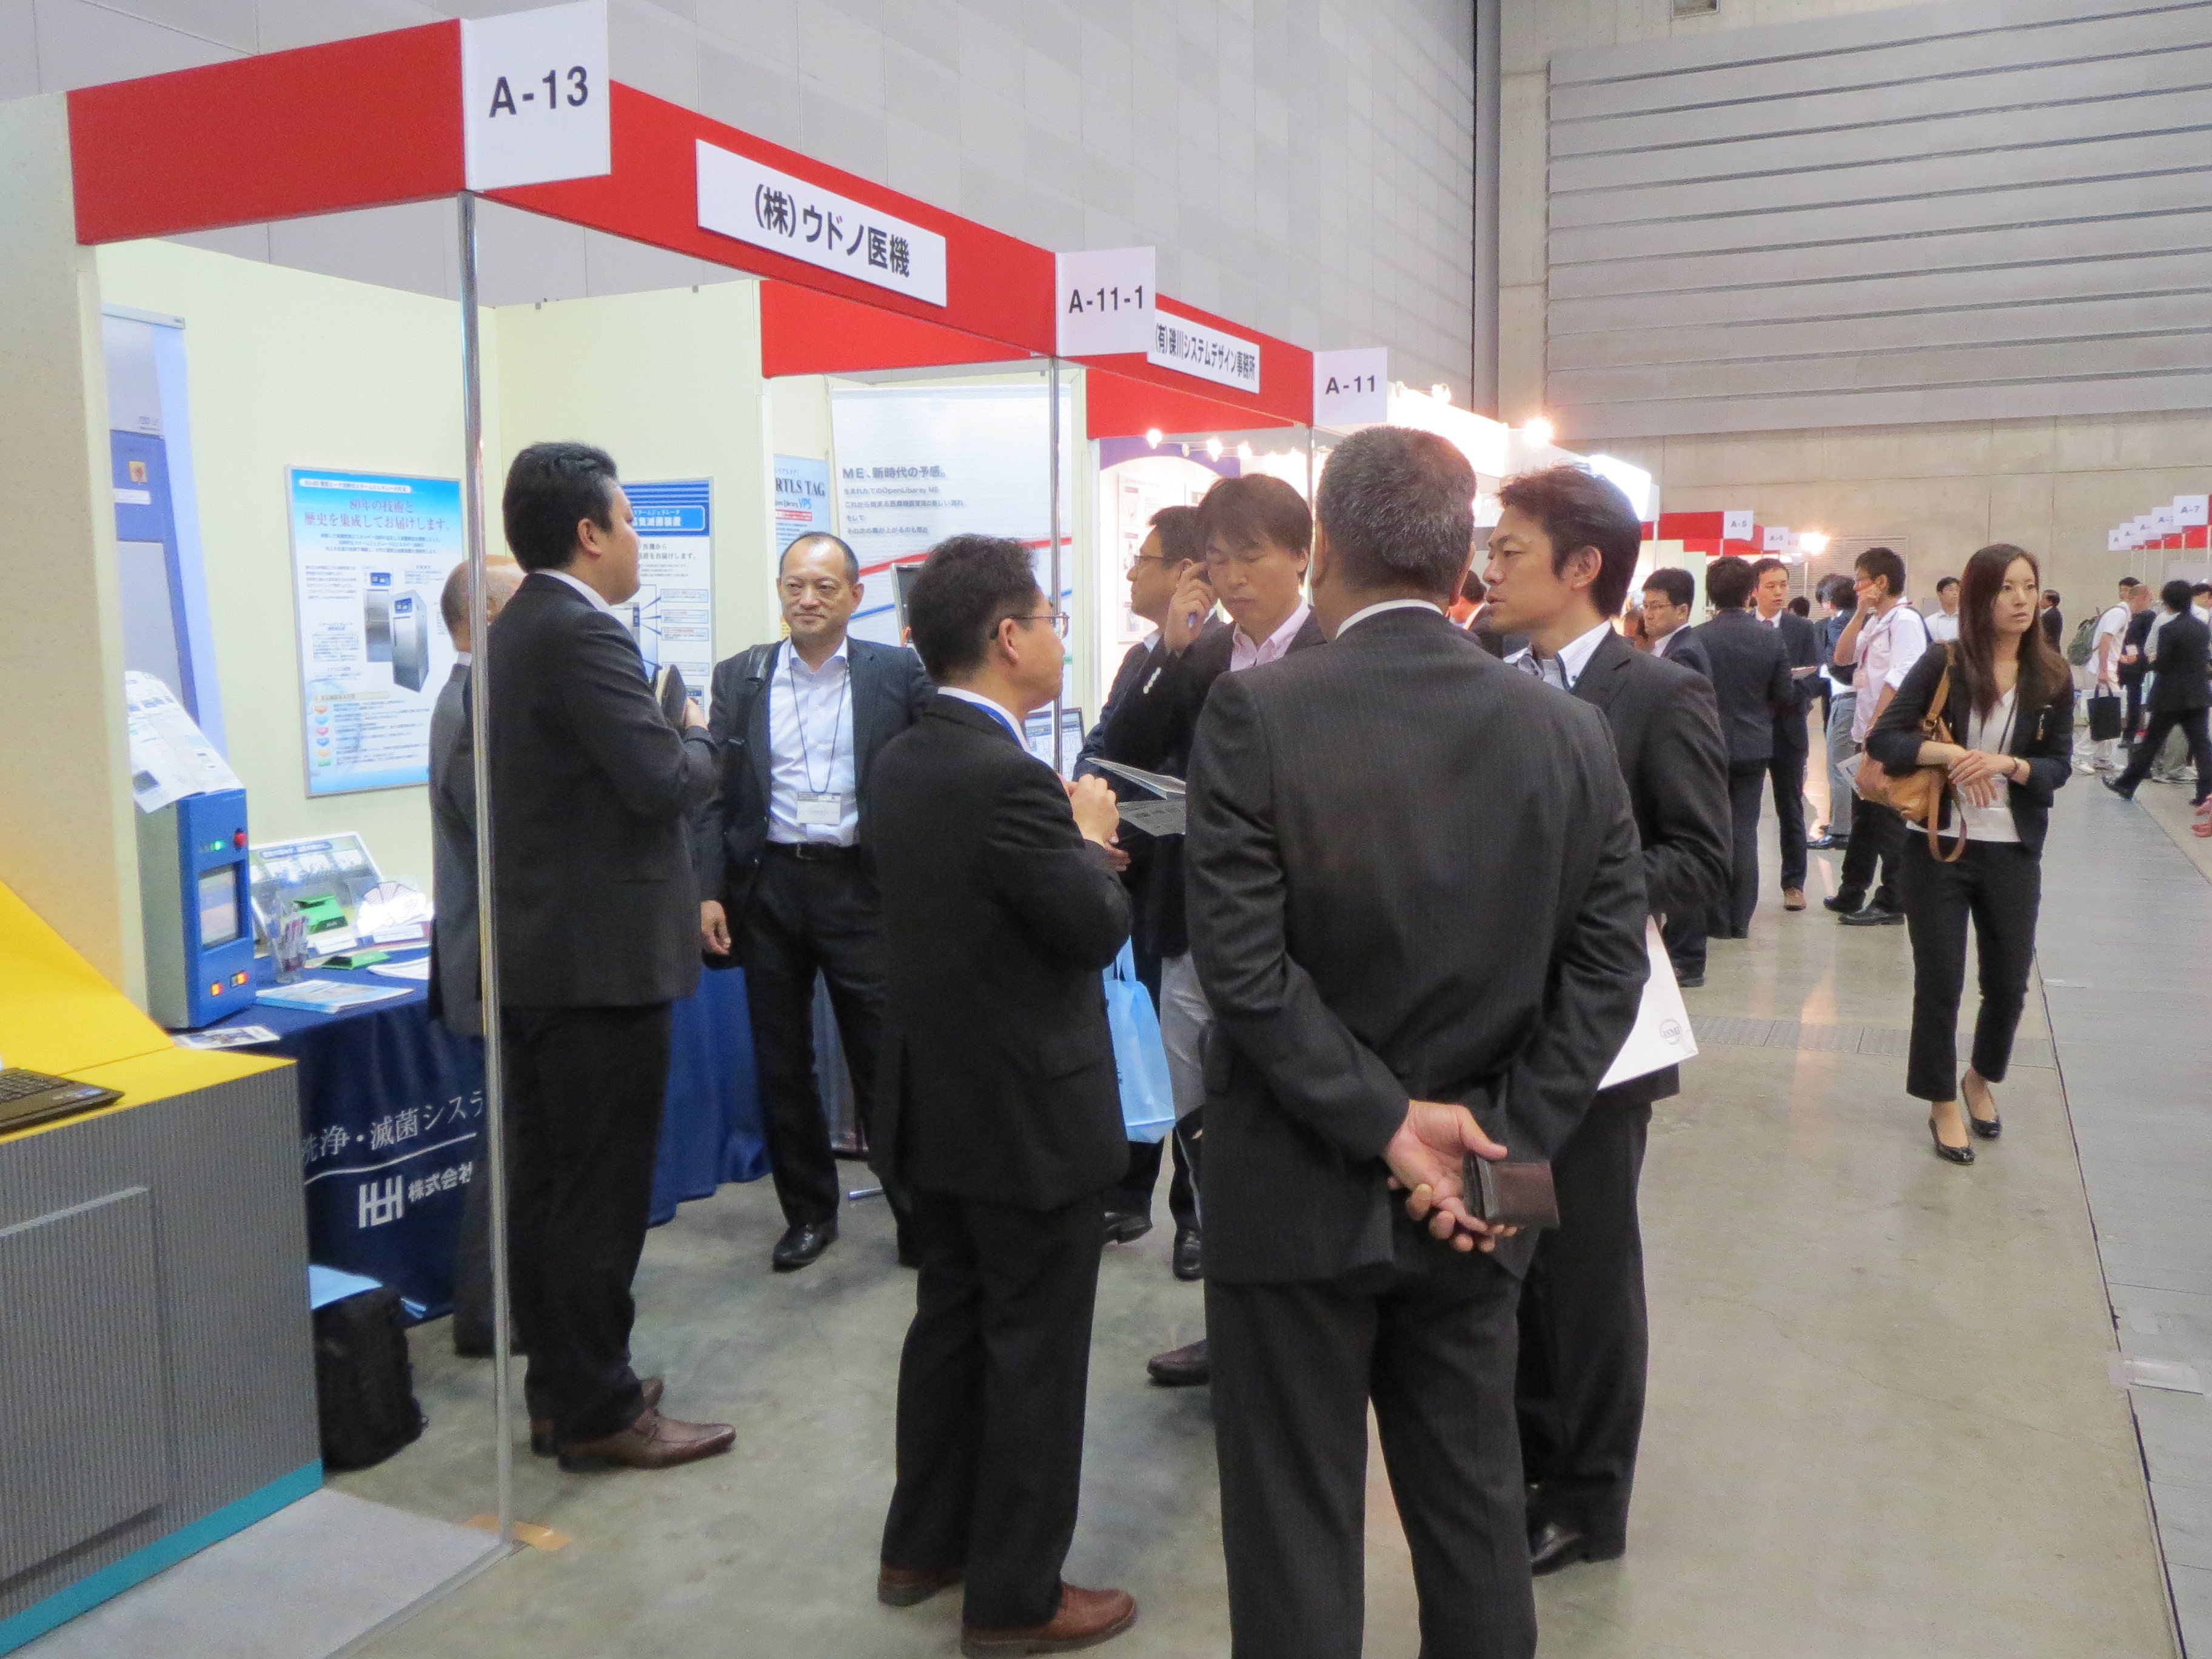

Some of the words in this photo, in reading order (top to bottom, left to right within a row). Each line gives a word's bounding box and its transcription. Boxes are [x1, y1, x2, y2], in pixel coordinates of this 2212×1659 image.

[489, 65, 588, 118] A-13
[756, 184, 910, 278] (株)ウドノ医機
[1069, 285, 1142, 313] A-11-1
[1325, 375, 1375, 395] A-11
[842, 466, 946, 479] ME、新時代の予感。
[776, 477, 802, 494] RTLS
[805, 480, 825, 496] TAG
[2180, 505, 2200, 514] A-7
